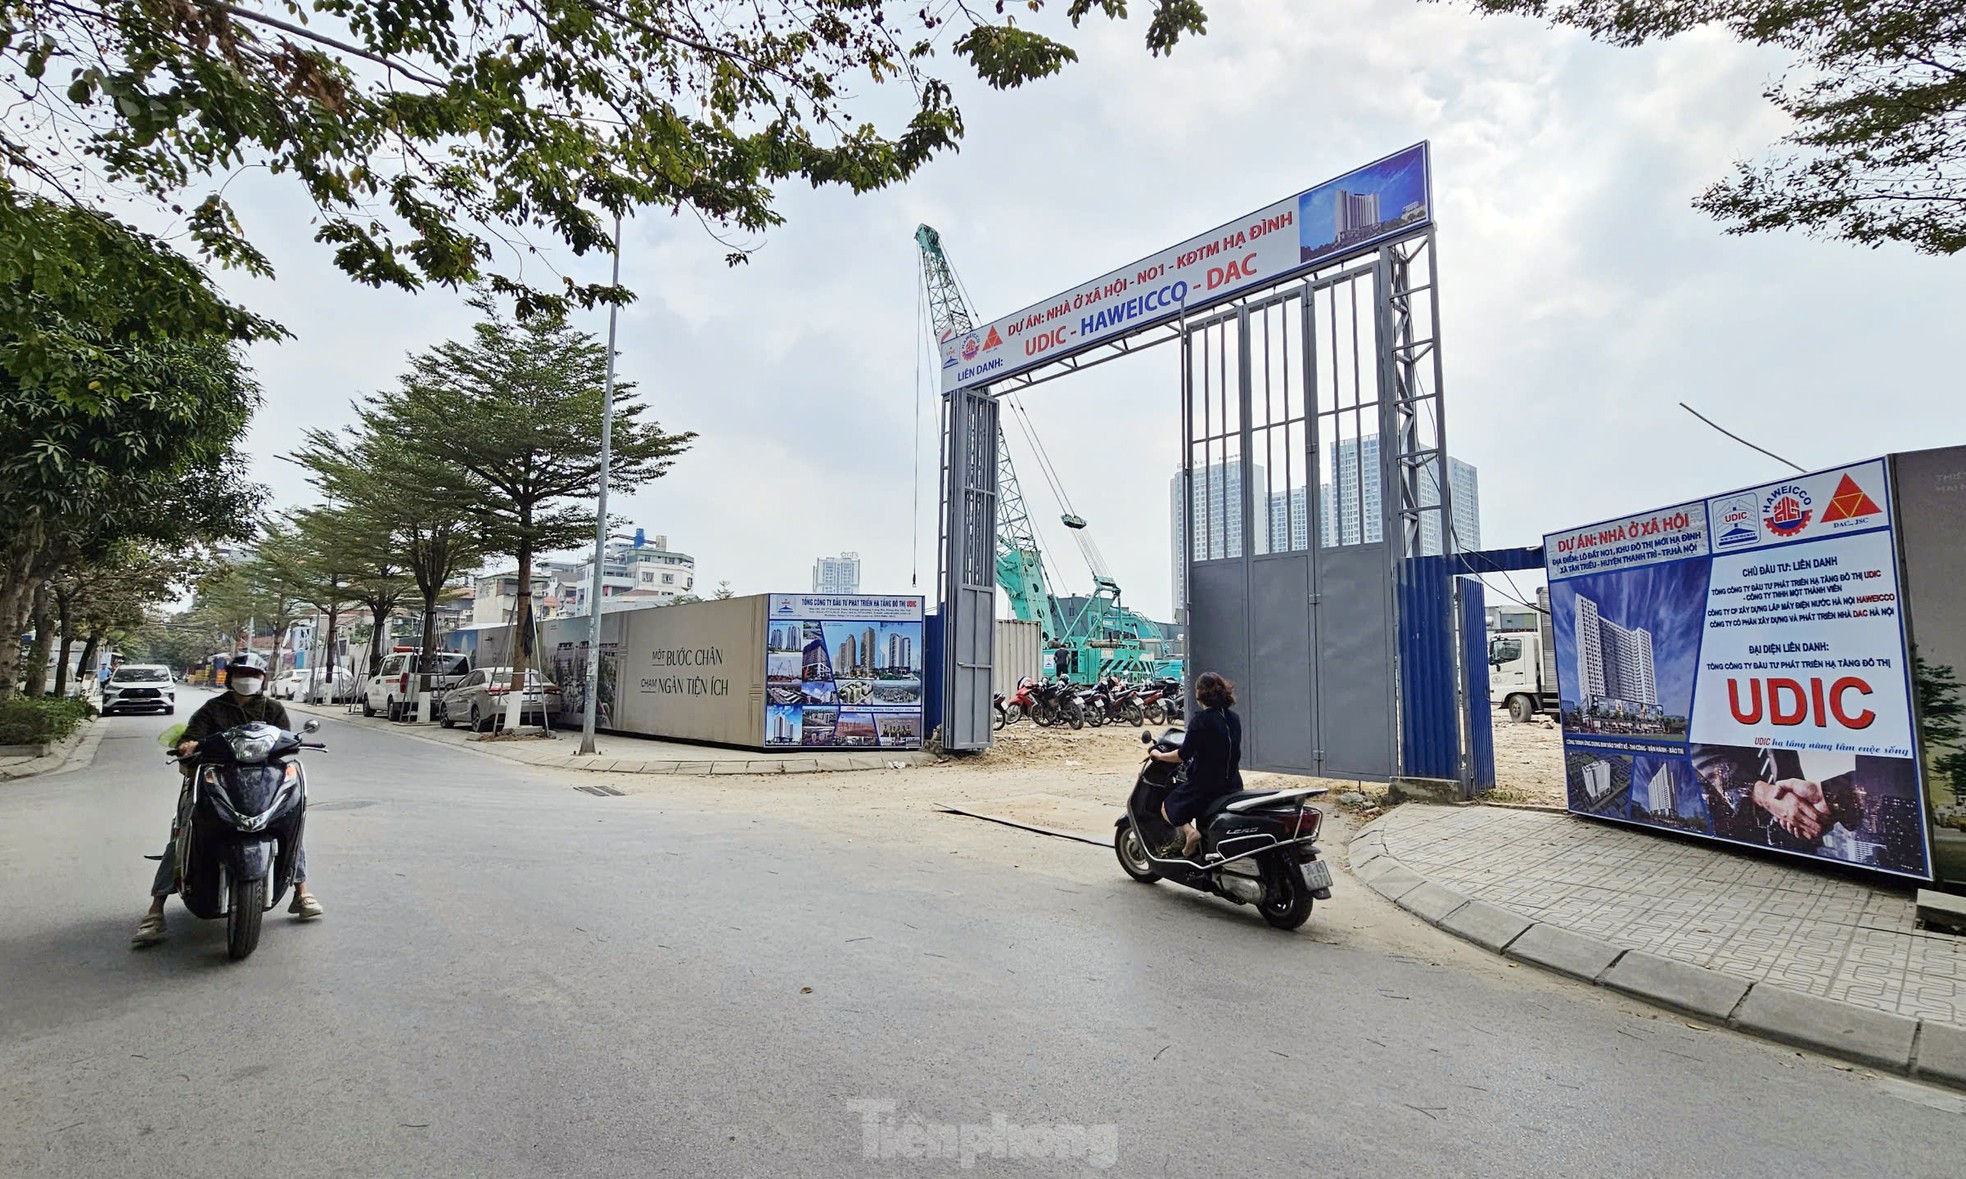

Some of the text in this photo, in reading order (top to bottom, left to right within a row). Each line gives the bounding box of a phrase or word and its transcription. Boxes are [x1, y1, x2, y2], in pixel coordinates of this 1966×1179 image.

[1008, 318, 1024, 336] DỰ
[1026, 313, 1045, 330] ÁN:
[1046, 300, 1071, 321] NHÀ
[1073, 294, 1083, 309] Ở
[1085, 287, 1101, 306] XÃ
[1104, 278, 1127, 298] HỘI
[1137, 263, 1164, 285] NO1
[1177, 240, 1220, 270] KĐTM
[1223, 230, 1246, 251] HẠ
[1249, 210, 1293, 240] ĐÌNH
[1025, 325, 1066, 356] UDIC
[1081, 280, 1188, 336] HAWEICCO
[1206, 252, 1258, 291] DAC
[958, 357, 1003, 382] LIÊN DANH:
[1763, 485, 1812, 513] HAWEICCO
[1725, 511, 1748, 523] UDIC
[1855, 517, 1869, 526] JSC
[1557, 511, 1690, 553] DỰ ÁN: NHÀ Ở XÃ HỘI
[1587, 549, 1600, 559] ĐẤT
[1616, 544, 1630, 555] KHU
[1630, 541, 1641, 552] ĐÔ
[1641, 540, 1654, 550] THỊ
[1654, 537, 1669, 547] MỚI
[1669, 535, 1681, 545] HẠ
[1681, 531, 1702, 542] ĐÌNH
[1568, 562, 1580, 572] TÂN
[1600, 556, 1622, 567] HUYỆN
[1622, 552, 1646, 564] THANH
[1646, 549, 1657, 559] TRÌ
[1683, 542, 1698, 554] NỘI
[1742, 556, 1838, 578] CHỦ ĐẦU TƯ: LIÊN DANH
[1726, 585, 1743, 594] CÔNG
[1751, 583, 1764, 592] ĐẦU
[1764, 582, 1773, 590] TƯ
[1773, 579, 1790, 588] PHÁT
[1809, 577, 1820, 585] HẠ
[1820, 574, 1839, 584] TẦNG
[1839, 571, 1851, 582] ĐÔ
[1851, 571, 1864, 581] THỊ
[1864, 569, 1881, 579] UDIC
[1746, 593, 1763, 601] CÔNG
[1772, 590, 1789, 599] TNHH
[1789, 588, 1803, 598] MỘT
[1804, 586, 1826, 595] THÀNH
[1826, 583, 1843, 592] VIÊN
[1707, 608, 1723, 617] CÔNG
[1723, 608, 1731, 616] TY
[1738, 605, 1750, 614] XÂY
[1750, 605, 1768, 614] DỰNG
[1795, 600, 1810, 610] ĐIỆN
[1811, 598, 1831, 608] NƯỚC
[1832, 597, 1842, 606] HÀ
[1842, 596, 1856, 606] NỘI
[1856, 593, 1895, 604] HAWEICCO
[1709, 620, 1725, 628] CÔNG
[1757, 616, 1770, 625] XÂY
[1770, 615, 1789, 625] DỰNG
[1789, 613, 1799, 622] VÀ
[1799, 612, 1817, 621] PHÁT
[1837, 609, 1852, 619] NHÀ
[1853, 609, 1868, 618] DAC
[1869, 607, 1880, 616] HÀ
[1881, 606, 1895, 617] NỘI
[651, 645, 724, 666] MỘT BƯỚC CHÂN
[1749, 641, 1829, 656] ĐẠI DIỆN LIÊN DANH:
[1724, 661, 1743, 670] CÔNG
[1753, 660, 1768, 669] ĐẦU
[1769, 661, 1780, 669] TƯ
[1780, 659, 1799, 669] PHÁT
[1801, 659, 1823, 668] TRIỂN
[1825, 660, 1836, 669] HẠ
[1838, 658, 1861, 667] TẦNG
[1862, 657, 1875, 667] ĐÔ
[1876, 658, 1891, 668] THỊ
[640, 675, 729, 698] CHẠM NGÀN TIỆN ÍCH
[1727, 676, 1876, 730] UDIC
[1754, 737, 1771, 746] UDIC
